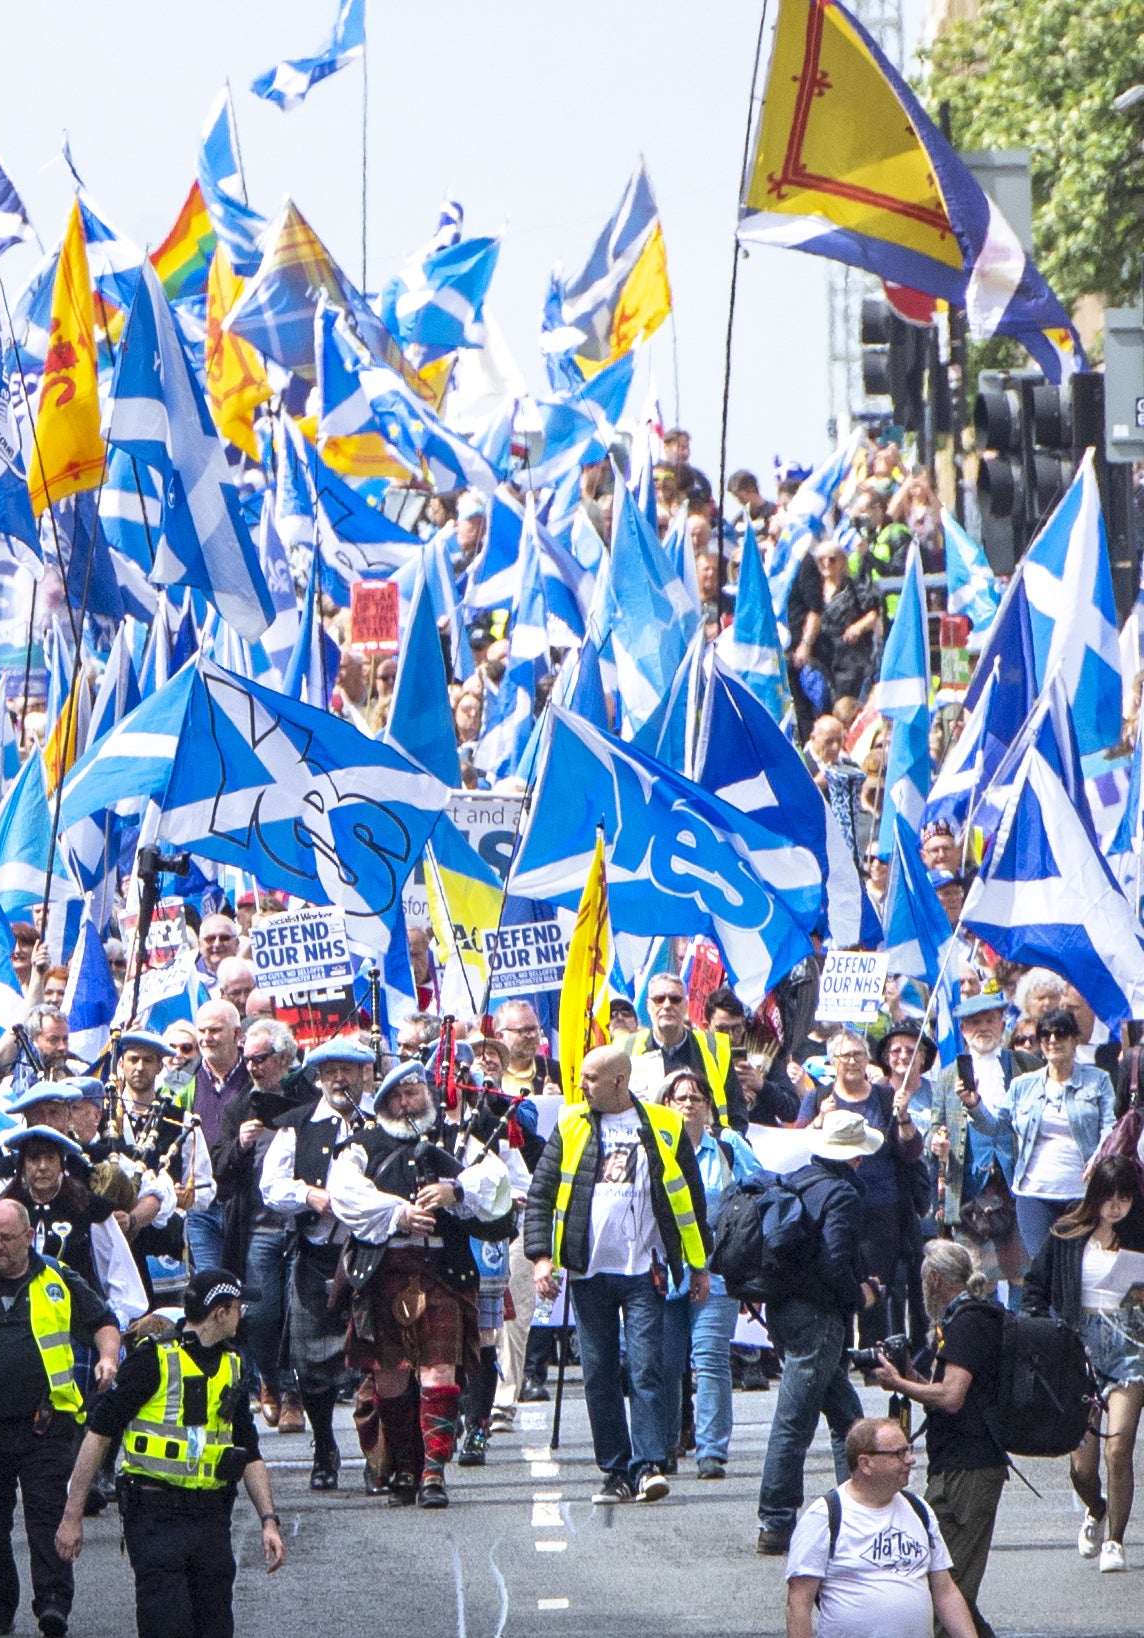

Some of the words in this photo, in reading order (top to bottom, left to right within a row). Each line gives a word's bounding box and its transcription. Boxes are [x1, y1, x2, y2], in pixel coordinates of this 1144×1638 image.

[356, 627, 392, 637] STATE
[466, 805, 504, 825] and
[300, 911, 334, 921] Worker
[252, 921, 329, 950] DEFEND
[485, 924, 562, 950] DEFEND
[256, 946, 299, 969] OUR
[303, 939, 346, 963] NHS
[488, 949, 531, 970] OUR
[825, 956, 877, 974] DEFEND
[823, 976, 852, 993] OUR
[854, 976, 882, 993] NHS
